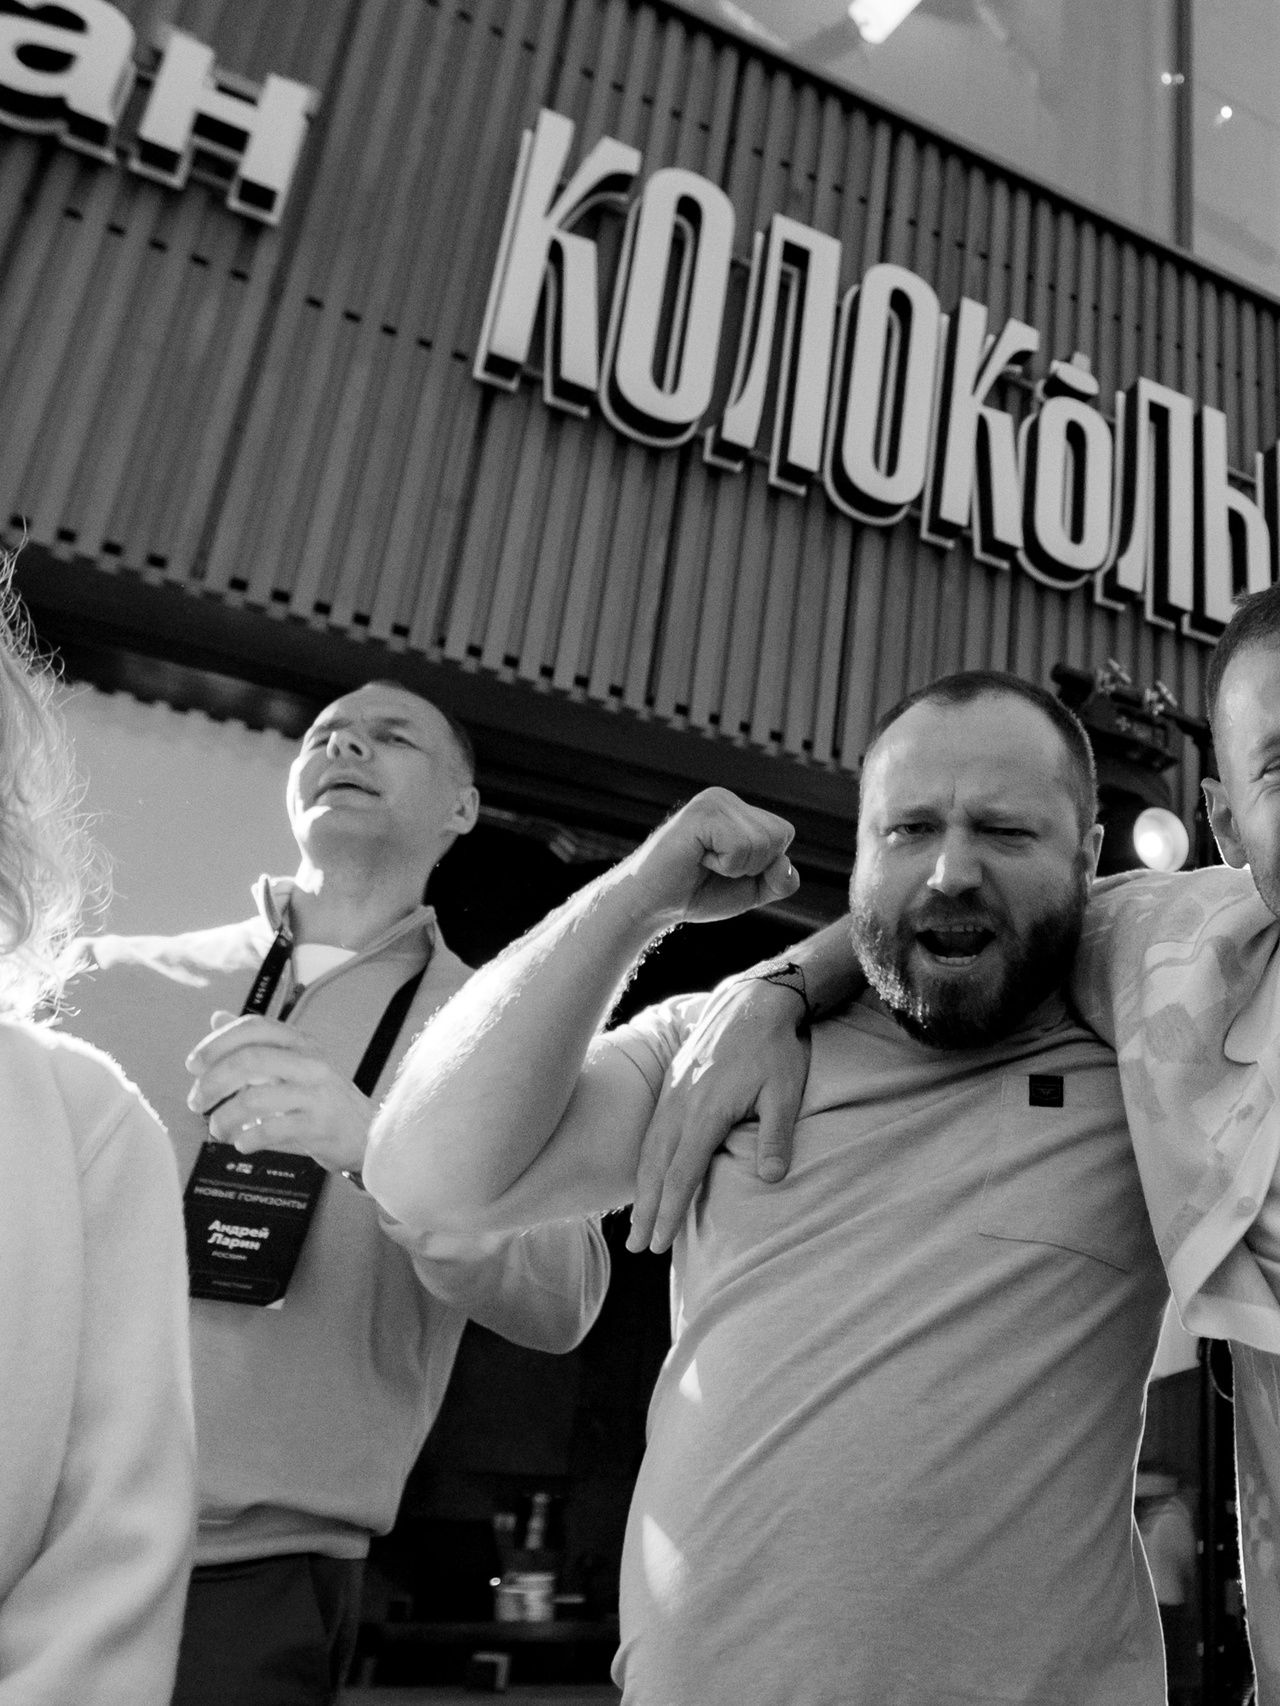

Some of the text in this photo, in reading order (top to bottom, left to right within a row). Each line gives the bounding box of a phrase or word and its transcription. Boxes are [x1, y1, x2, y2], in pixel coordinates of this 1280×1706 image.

[194, 1186, 236, 1199] НОВЫЕ
[238, 1192, 307, 1209] ГОРИЗОНТЫ
[208, 1219, 270, 1239] Андрей
[207, 1232, 261, 1250] Ларин
